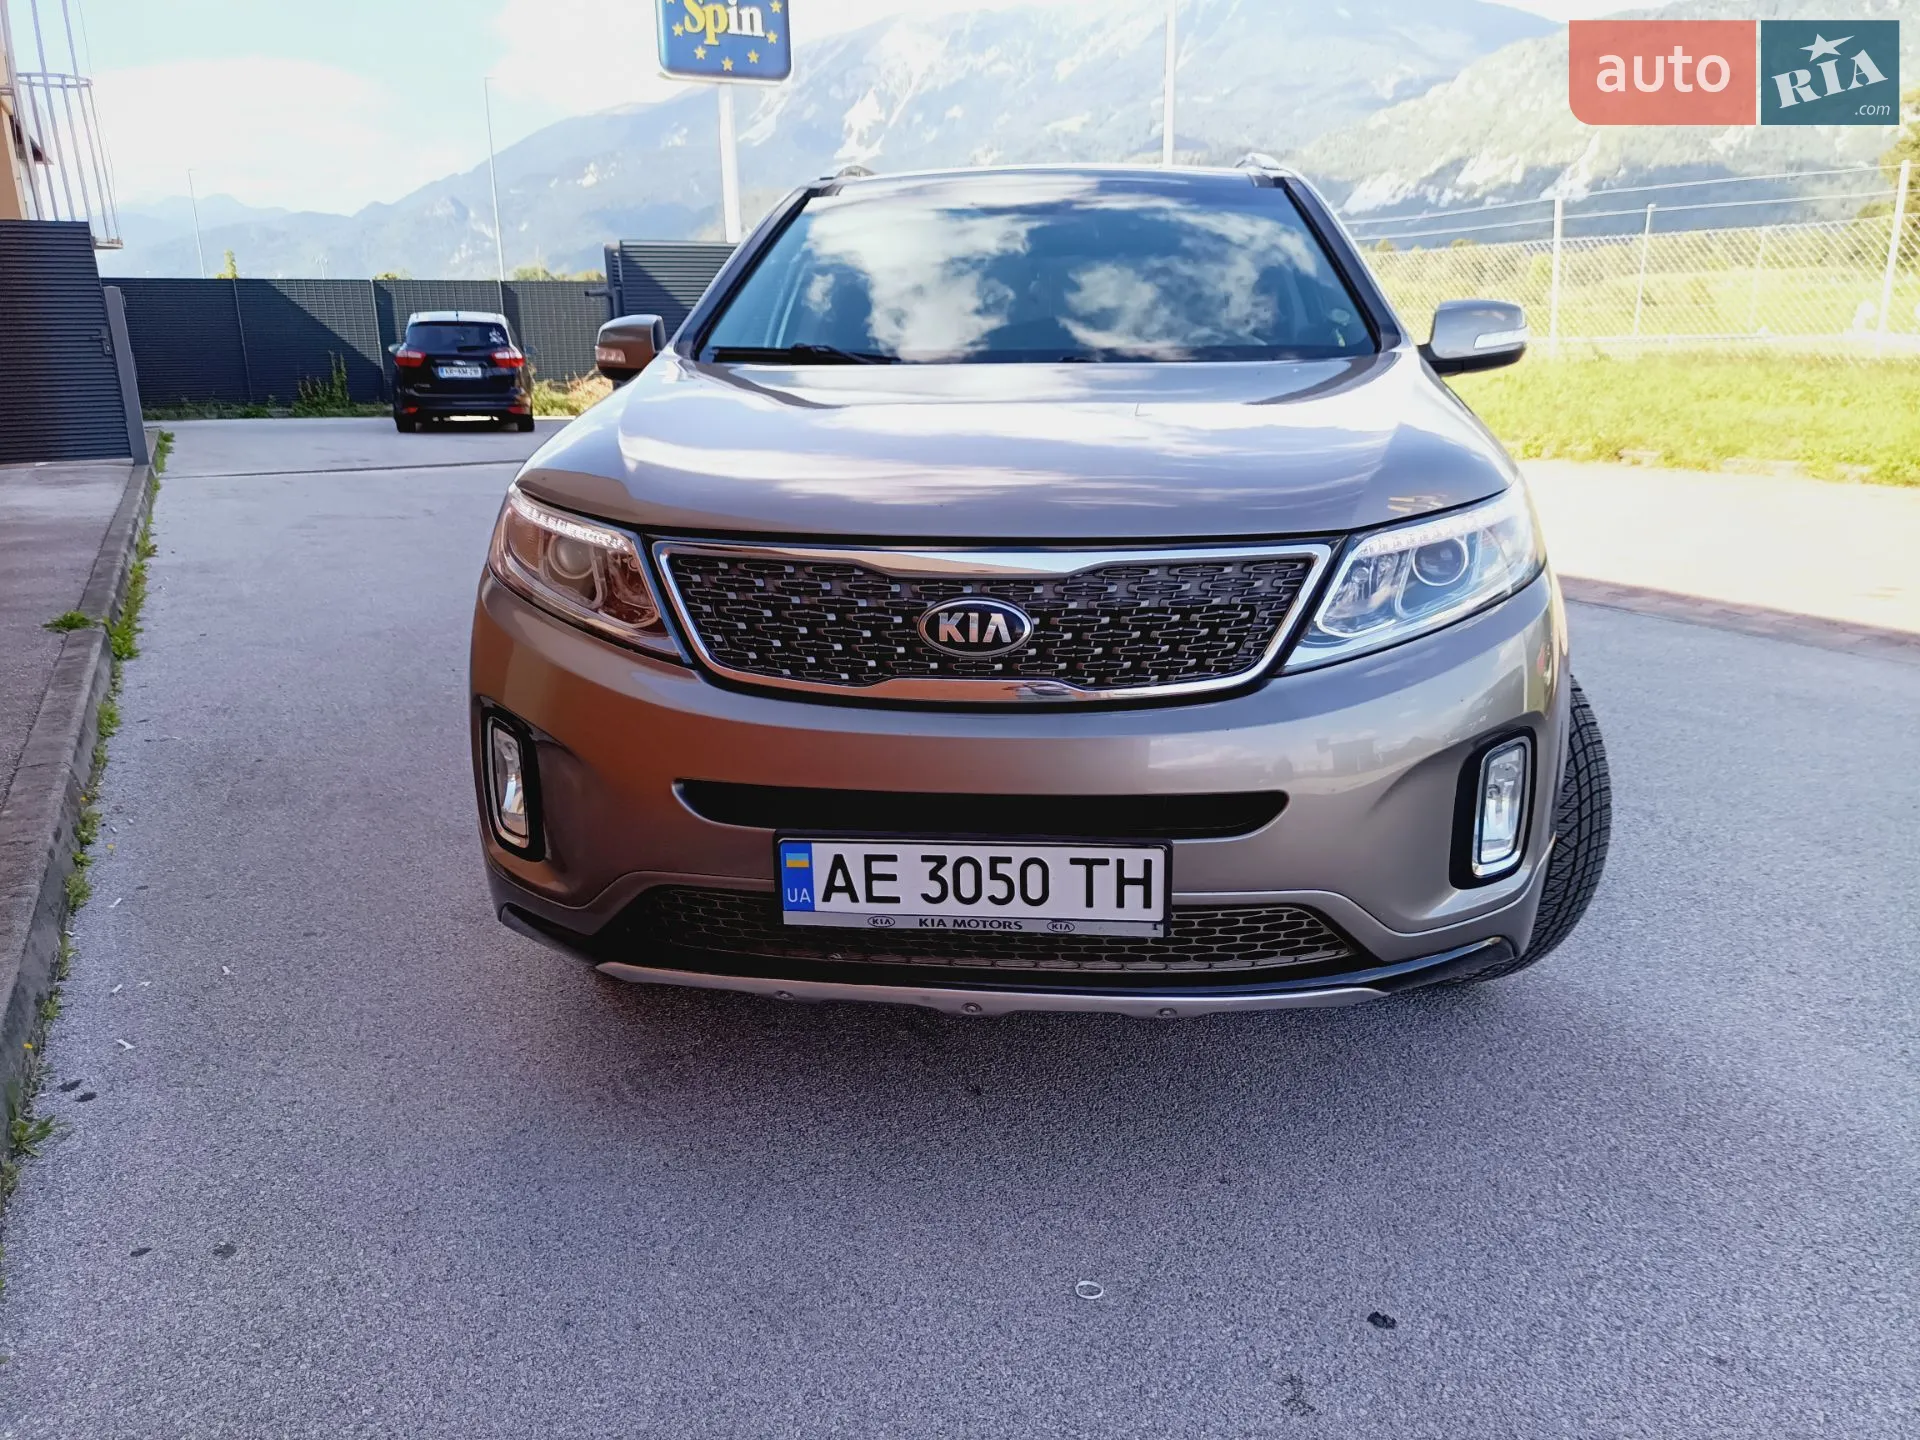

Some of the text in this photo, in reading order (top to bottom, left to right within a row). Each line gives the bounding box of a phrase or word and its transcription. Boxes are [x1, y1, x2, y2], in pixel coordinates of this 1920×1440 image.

[683, 0, 767, 46] Spin
[938, 612, 1012, 643] KIA
[821, 853, 1153, 910] AE 3050 TH
[787, 887, 811, 903] UA
[871, 917, 892, 926] KIA
[918, 917, 1023, 931] KIA MOTORS
[1051, 922, 1071, 931] KIA
